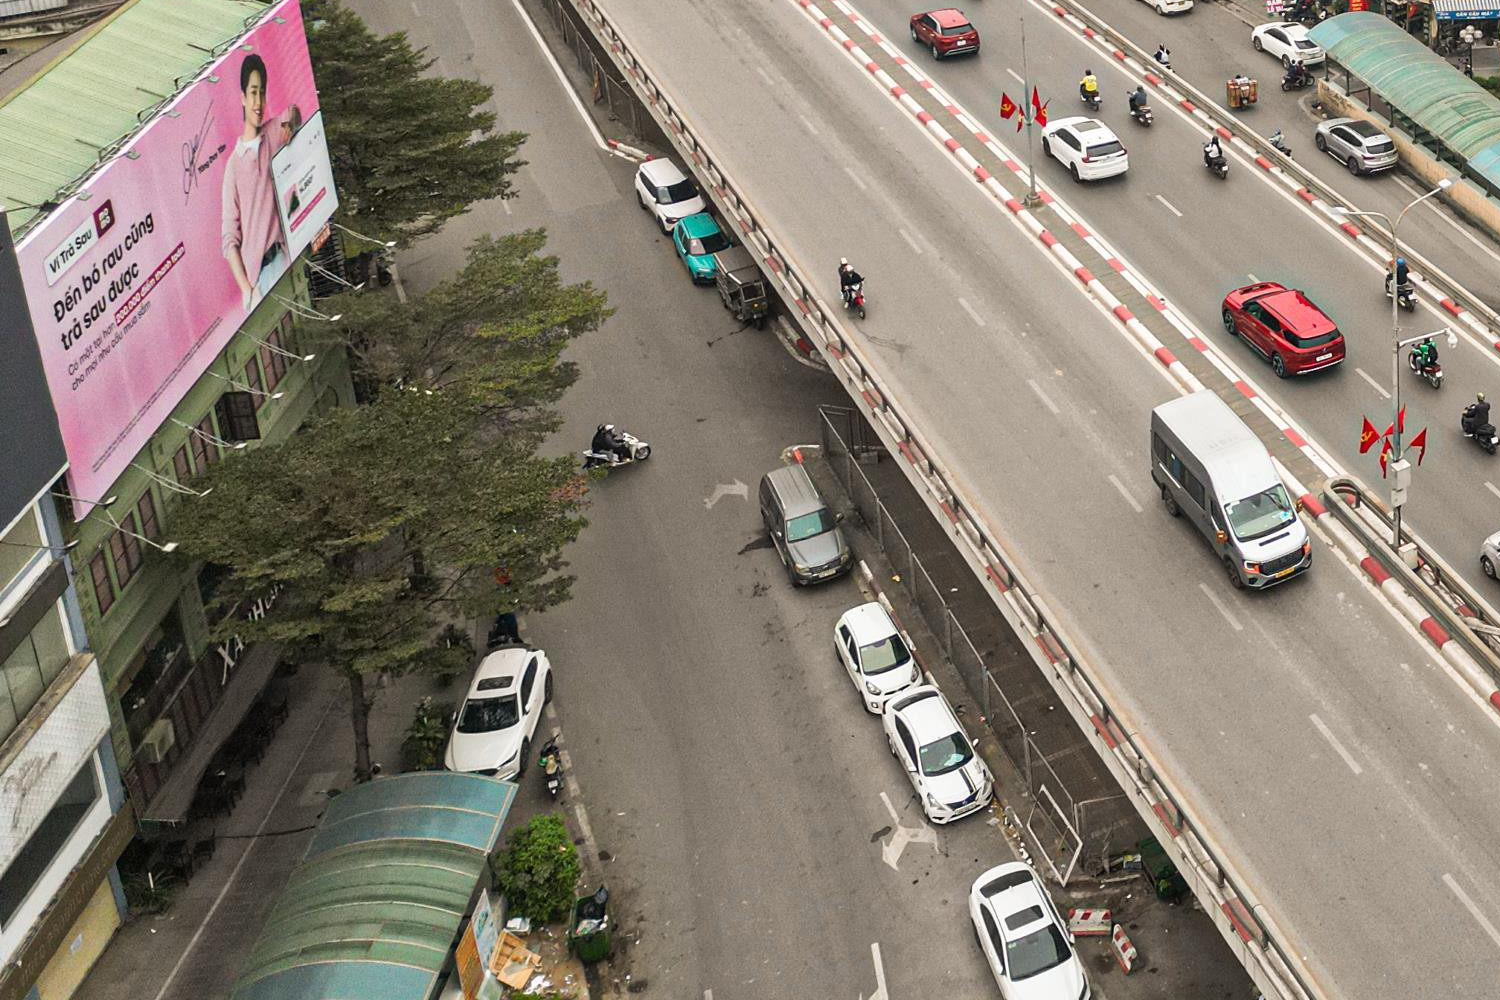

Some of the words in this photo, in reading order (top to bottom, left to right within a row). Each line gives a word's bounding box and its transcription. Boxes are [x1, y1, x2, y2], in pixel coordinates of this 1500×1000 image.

[49, 259, 60, 274] Ví
[58, 242, 76, 263] Trả
[75, 229, 93, 250] Sau
[53, 283, 83, 324] Đến
[82, 263, 101, 295] bó
[102, 243, 124, 277] rau
[124, 212, 155, 251] cũng
[60, 317, 84, 351] trả
[83, 297, 107, 334] sau
[108, 261, 140, 303] được
[71, 373, 85, 392] cho
